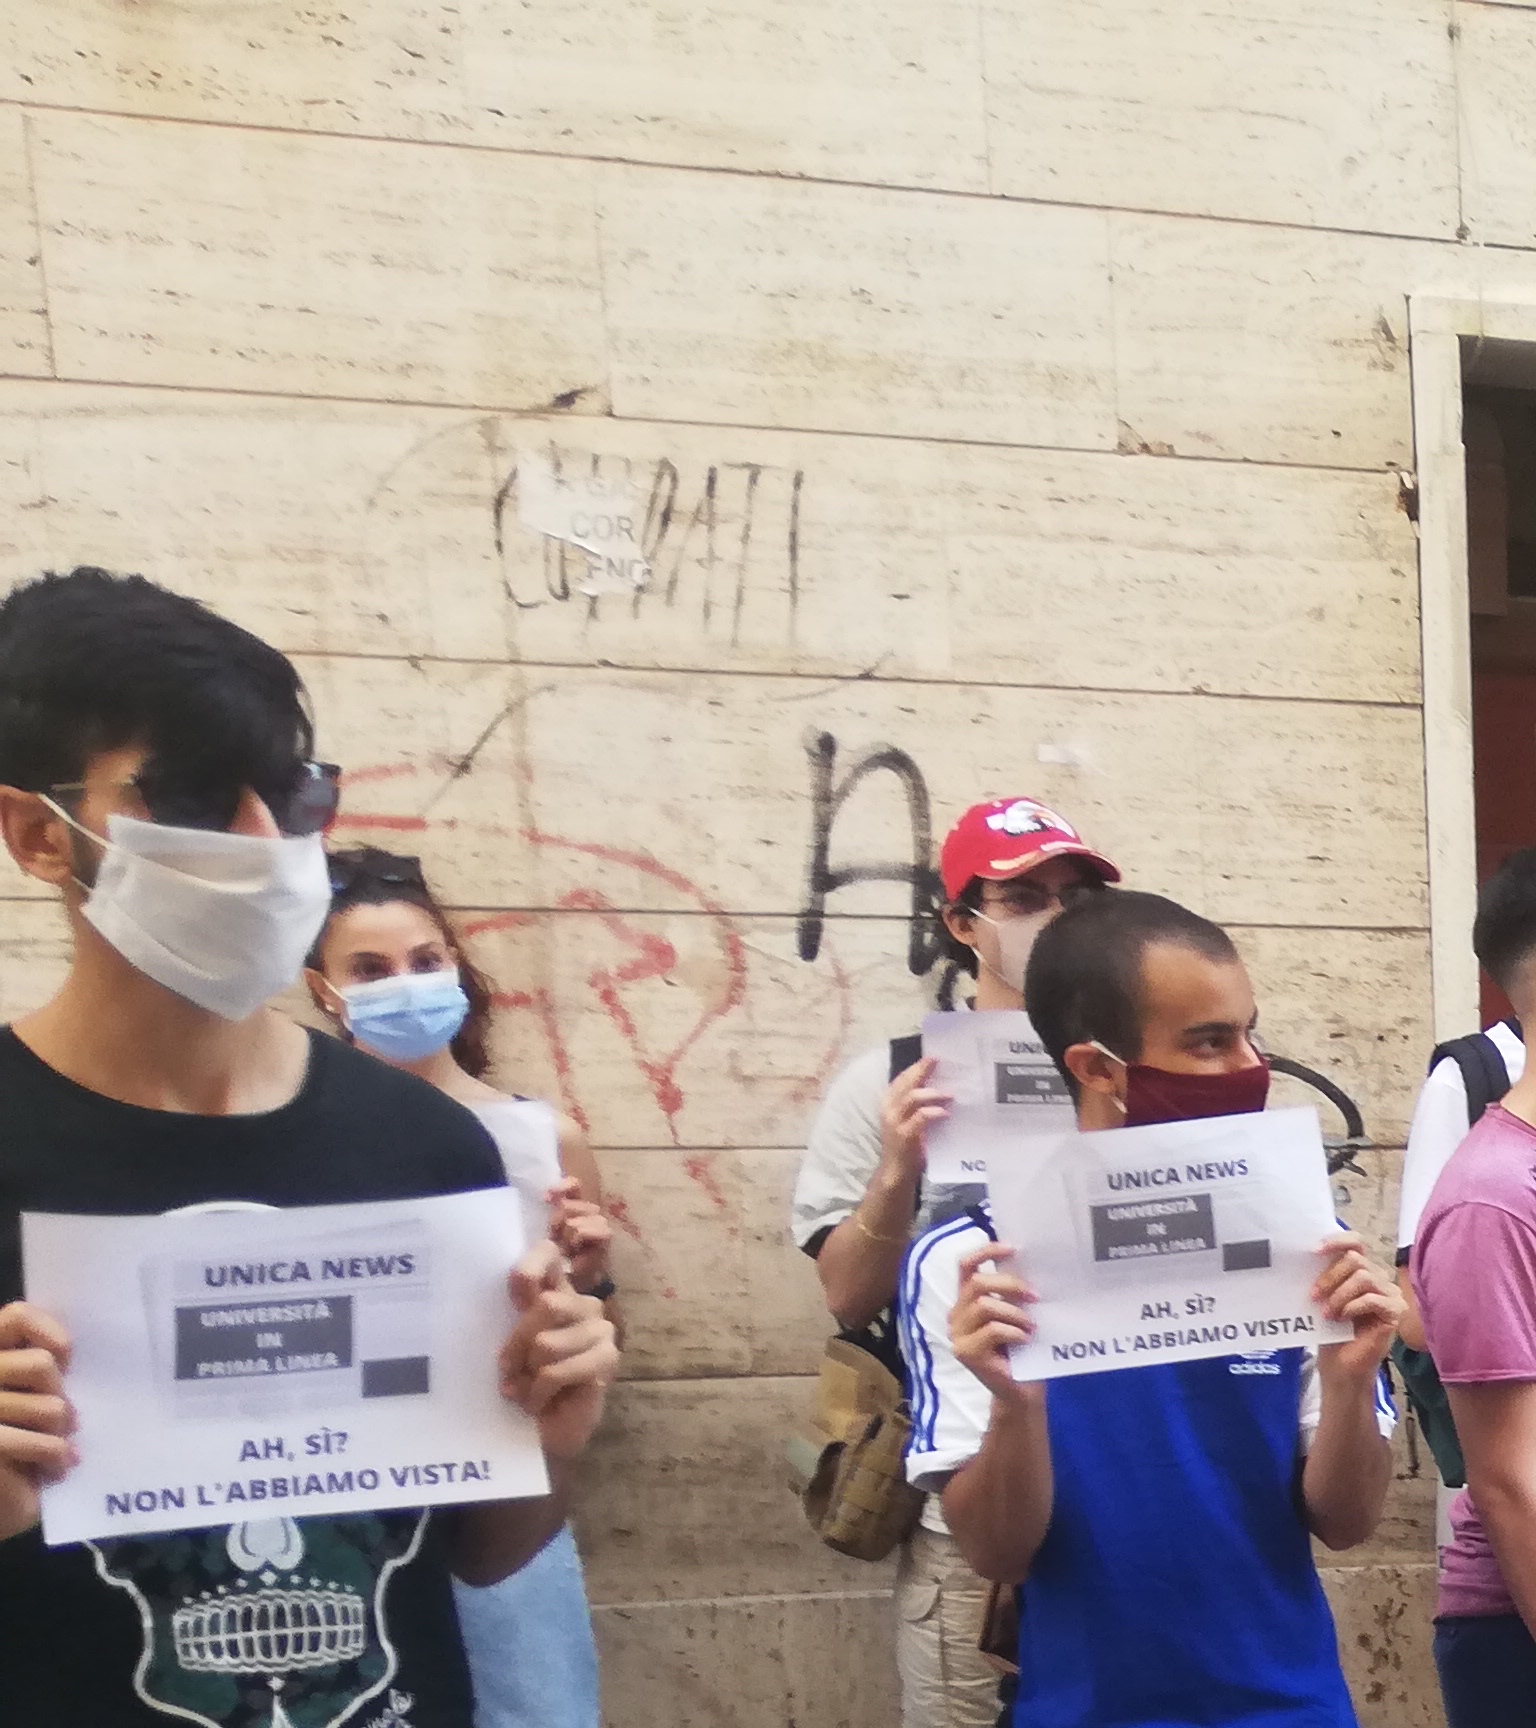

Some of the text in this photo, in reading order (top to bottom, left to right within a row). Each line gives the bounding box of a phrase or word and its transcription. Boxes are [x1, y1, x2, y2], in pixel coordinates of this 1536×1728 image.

[1106, 1158, 1249, 1190] UNICA NEWS
[204, 1253, 416, 1288] UNICA NEWS
[1140, 1293, 1217, 1321] AH, SÌ?
[1051, 1315, 1316, 1362] NON L'ABBIAMO VISTA!
[1228, 1360, 1282, 1376] adidas
[238, 1425, 350, 1463] AH, SÌ?
[104, 1458, 492, 1517] NON L'ABBIAMO VISTA!
